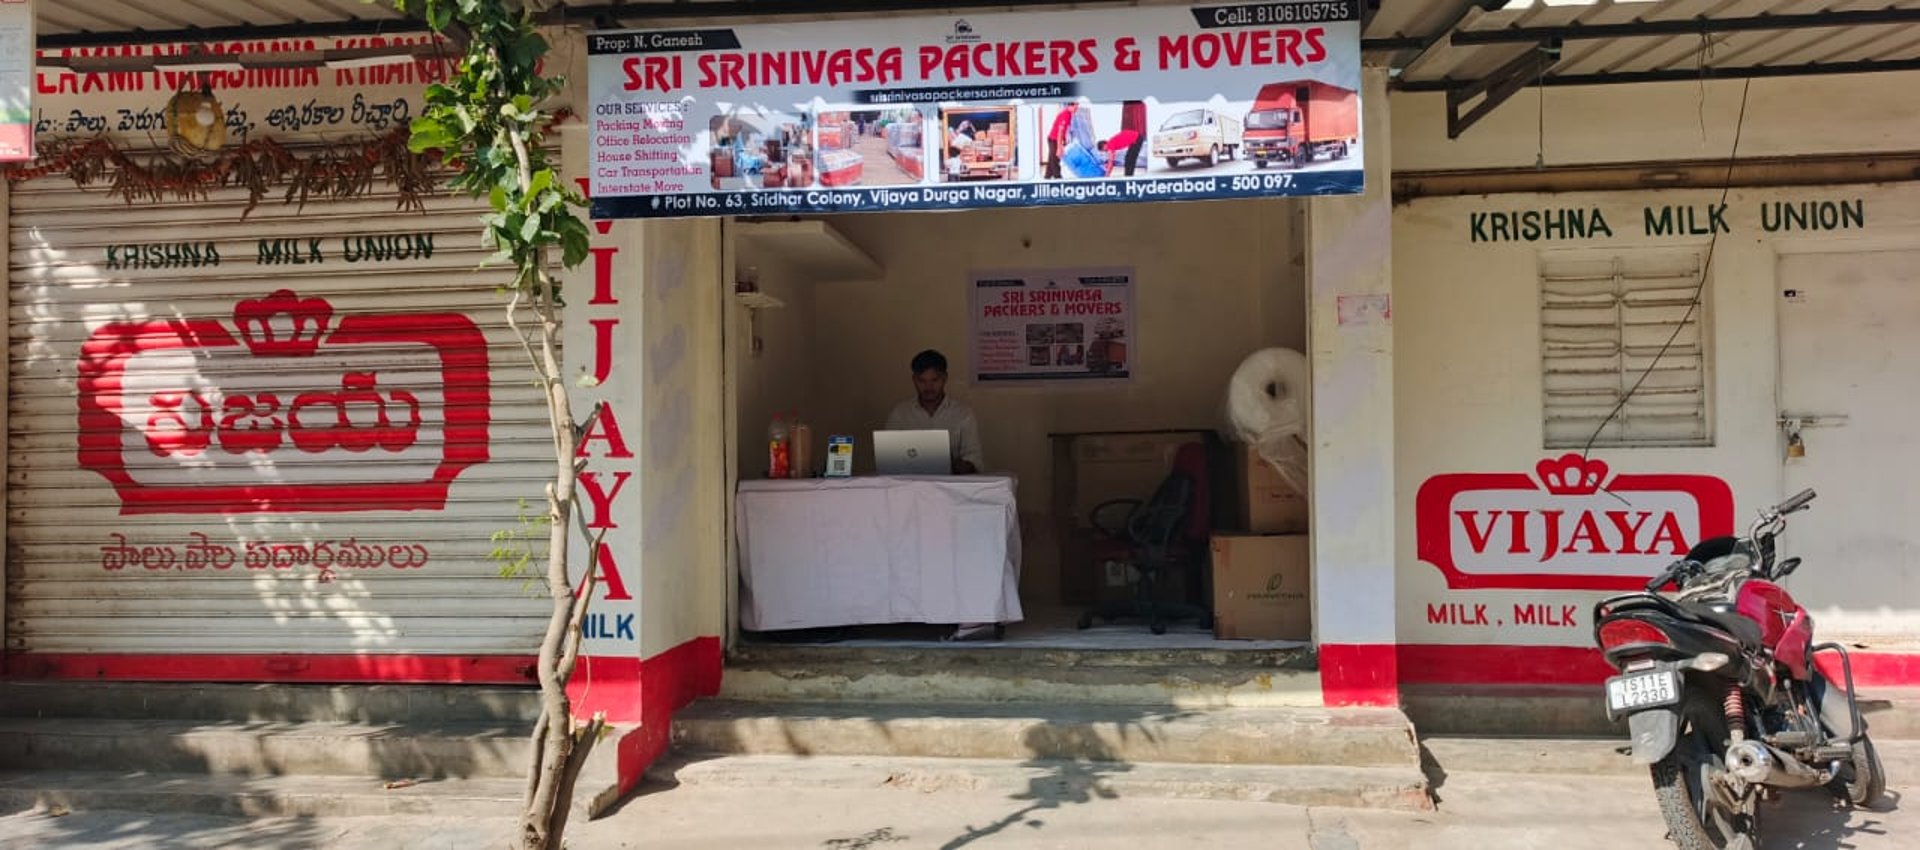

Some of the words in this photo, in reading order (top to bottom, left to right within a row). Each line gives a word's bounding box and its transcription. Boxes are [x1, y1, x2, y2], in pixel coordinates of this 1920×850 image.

[1214, 7, 1252, 24] Cell:
[1257, 3, 1349, 21] 8106105755
[596, 36, 630, 52] Prop:
[634, 35, 648, 49] N.
[651, 33, 703, 47] Ganesh
[622, 55, 683, 93] SRI
[698, 47, 903, 91] SRINIVASA
[919, 38, 1098, 83] PACKERS
[1114, 37, 1140, 71] &
[1158, 27, 1327, 71] MOVERS
[596, 103, 622, 115] OUR
[597, 120, 639, 132] Packing
[597, 135, 630, 146] Office
[633, 134, 691, 145] Relocation
[597, 151, 632, 162] House
[635, 149, 677, 162] Shifting
[598, 168, 617, 177] Car
[621, 166, 702, 178] Transportation
[598, 183, 650, 194] Interstate
[654, 181, 684, 192] Move
[665, 196, 690, 209] Plot
[695, 195, 721, 208] No.
[751, 192, 802, 206] Sridhar
[807, 190, 865, 207] Colony,
[871, 189, 918, 206] Vijaya
[923, 187, 969, 205] Durga
[974, 186, 1026, 203] Nagar,
[1030, 183, 1121, 200] Jillelaguda,
[1126, 178, 1216, 197] Hyderabad
[1232, 177, 1259, 191] 500
[1264, 175, 1297, 189] 097.
[1470, 208, 1613, 243] KRISHNA
[1644, 203, 1731, 236] MILK
[1761, 199, 1865, 233] UNION
[105, 241, 221, 269] KRISHNA
[257, 237, 324, 265] MILK
[343, 232, 435, 263] UNION
[1002, 291, 1024, 304] SRI
[1029, 288, 1103, 303] SRINIVASA
[984, 304, 1045, 317] PACKERS
[1065, 302, 1122, 315] MOVERS
[1454, 509, 1691, 562] VIJAYA
[1427, 603, 1489, 626] MILK
[1514, 603, 1577, 627] MILK
